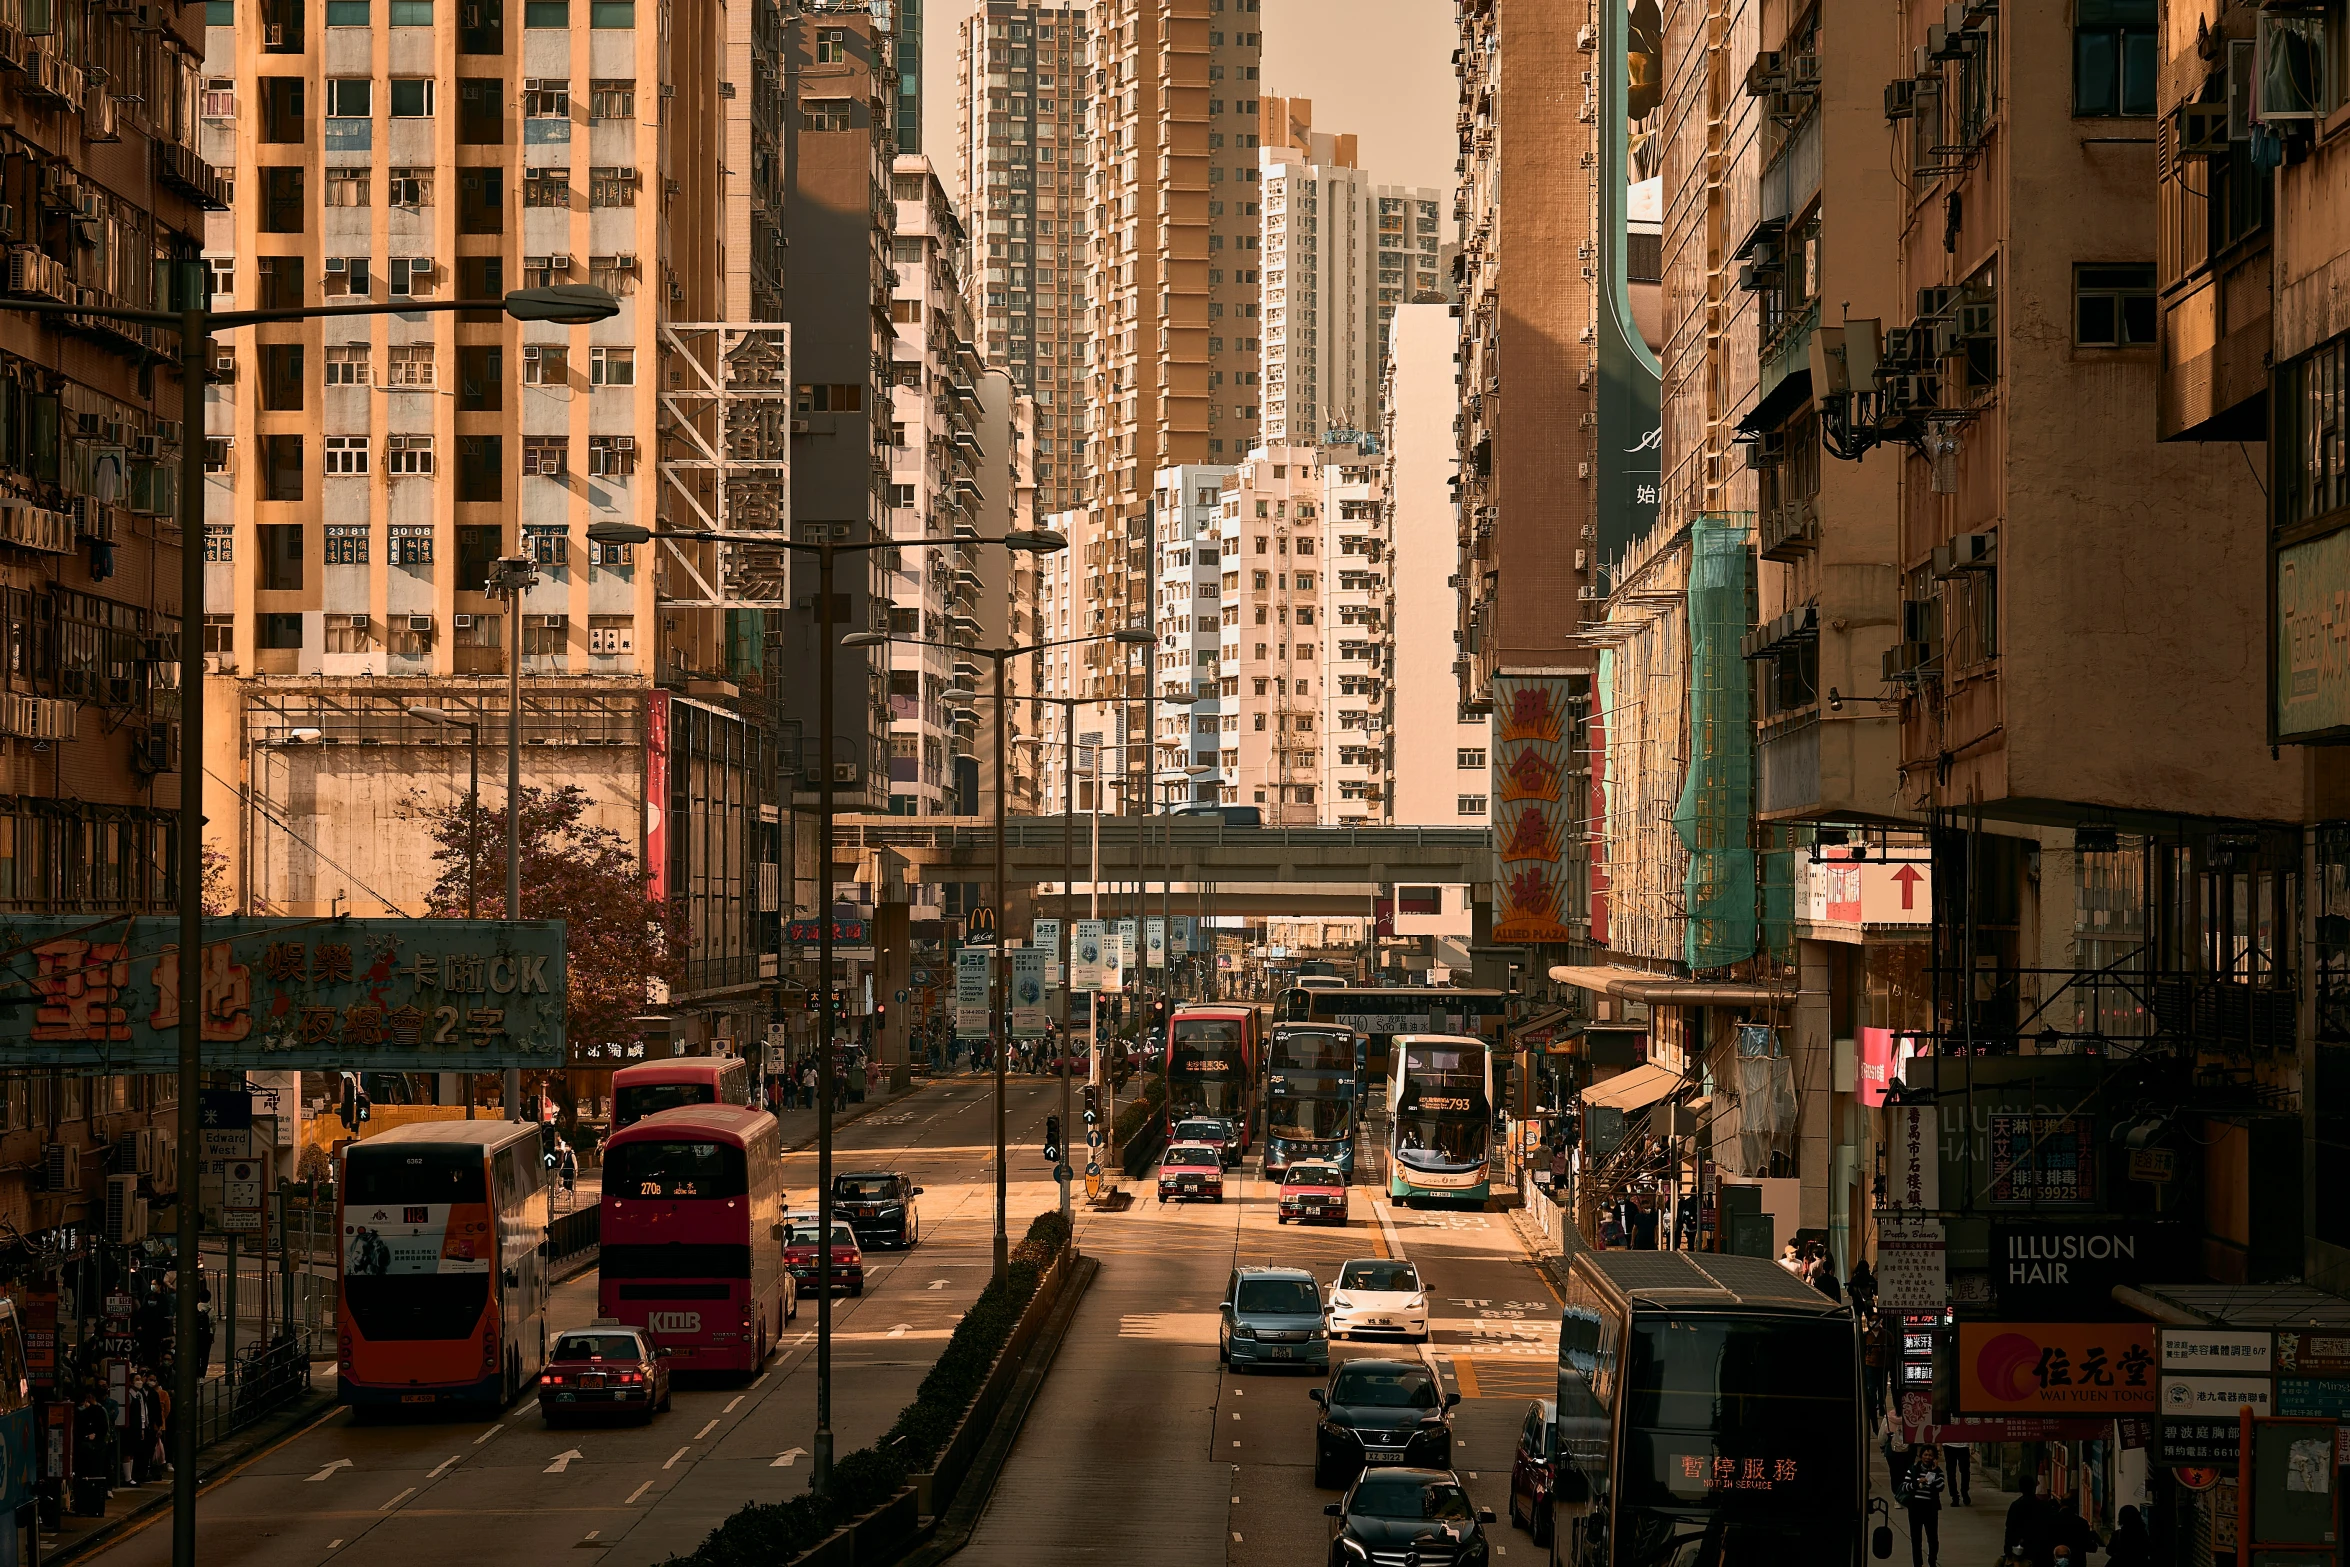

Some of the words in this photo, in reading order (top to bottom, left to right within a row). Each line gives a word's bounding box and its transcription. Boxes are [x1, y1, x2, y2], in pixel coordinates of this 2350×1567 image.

[725, 330, 784, 600] 金都商場
[1637, 485, 1661, 504] 始
[328, 528, 344, 536] 23
[352, 528, 366, 536] 81
[392, 528, 408, 536] 80
[415, 527, 431, 536] 08
[326, 539, 336, 562] 香港
[342, 539, 353, 562] 私家
[357, 539, 368, 562] 偵探
[406, 539, 416, 562] 私家
[420, 539, 431, 562] 香港
[1509, 687, 1556, 914] 聯合廣場
[1036, 924, 1056, 932] DES
[1494, 929, 1530, 940] ALLIED
[1532, 928, 1568, 940] PLAZA
[960, 954, 986, 966] DES
[265, 941, 354, 983] 娛樂
[399, 952, 550, 995] 卡啦OK
[30, 939, 253, 1042] 聖地
[810, 992, 840, 1000] 太城
[299, 1004, 507, 1046] 夜總會2字
[1377, 1020, 1394, 1033] Spa
[1213, 1060, 1229, 1071] 35A
[1449, 1099, 1470, 1111] 793
[2012, 1119, 2076, 1134] 淋巴推拿
[206, 1133, 246, 1143] Edward
[210, 1145, 236, 1155] West
[1938, 1137, 1984, 1162] HAI
[2047, 1170, 2077, 1185] 排毒
[248, 1184, 254, 1193] 7
[641, 1182, 661, 1195] 270B
[407, 1207, 424, 1223] 118
[1884, 1230, 1908, 1239] Pretty
[1912, 1230, 1938, 1239] Beauty
[268, 1238, 279, 1246] 12
[2009, 1235, 2135, 1259] ILLUSION
[2009, 1262, 2069, 1284] HAIR
[649, 1312, 701, 1333] KMB
[106, 1339, 133, 1352] N73
[2166, 1341, 2188, 1349] 碧波庭
[2188, 1345, 2252, 1357] 美容纖體調理
[2253, 1347, 2266, 1355] 6/F
[2033, 1344, 2155, 1388] 位元堂
[2040, 1390, 2066, 1401] WAI
[2071, 1390, 2108, 1401] YUEN
[2114, 1390, 2155, 1401] TONG
[2197, 1392, 2268, 1403] 港九電器商聯會
[2164, 1426, 2255, 1439] 碧波庭胸部
[1681, 1456, 1798, 1482] 暫停服務
[1703, 1479, 1721, 1487] NOT
[1723, 1480, 1732, 1488] IN
[1736, 1480, 1773, 1490] SERVICE
